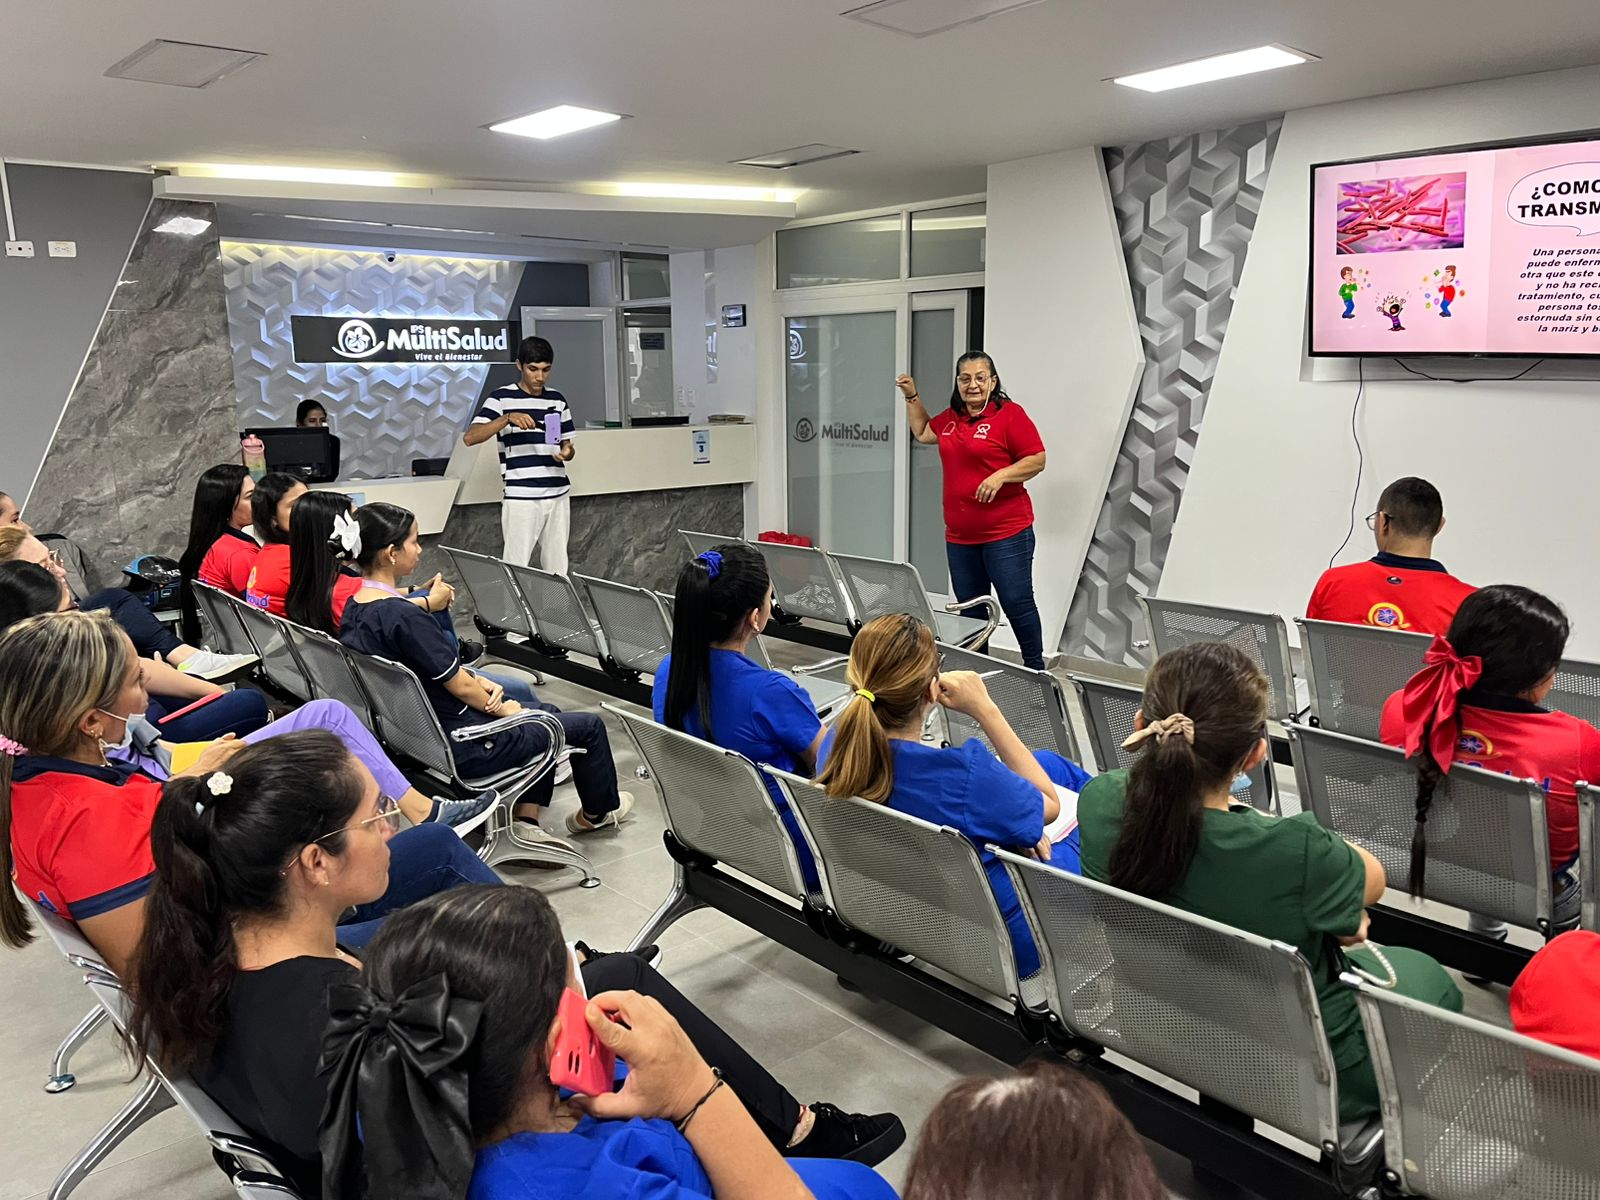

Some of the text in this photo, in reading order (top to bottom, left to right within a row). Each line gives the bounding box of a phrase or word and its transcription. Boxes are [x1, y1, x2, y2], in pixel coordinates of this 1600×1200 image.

[1531, 179, 1600, 200] ¿COMO
[1518, 201, 1600, 218] TRANSM
[1527, 259, 1561, 269] puede
[1545, 271, 1566, 279] que
[1518, 292, 1585, 301] tratamiento,
[1537, 304, 1583, 312] persona
[1575, 313, 1592, 321] sin
[410, 325, 424, 333] IPS
[1581, 326, 1589, 334] y
[387, 326, 507, 350] MultiSalud
[821, 423, 889, 442] MultiSalud
